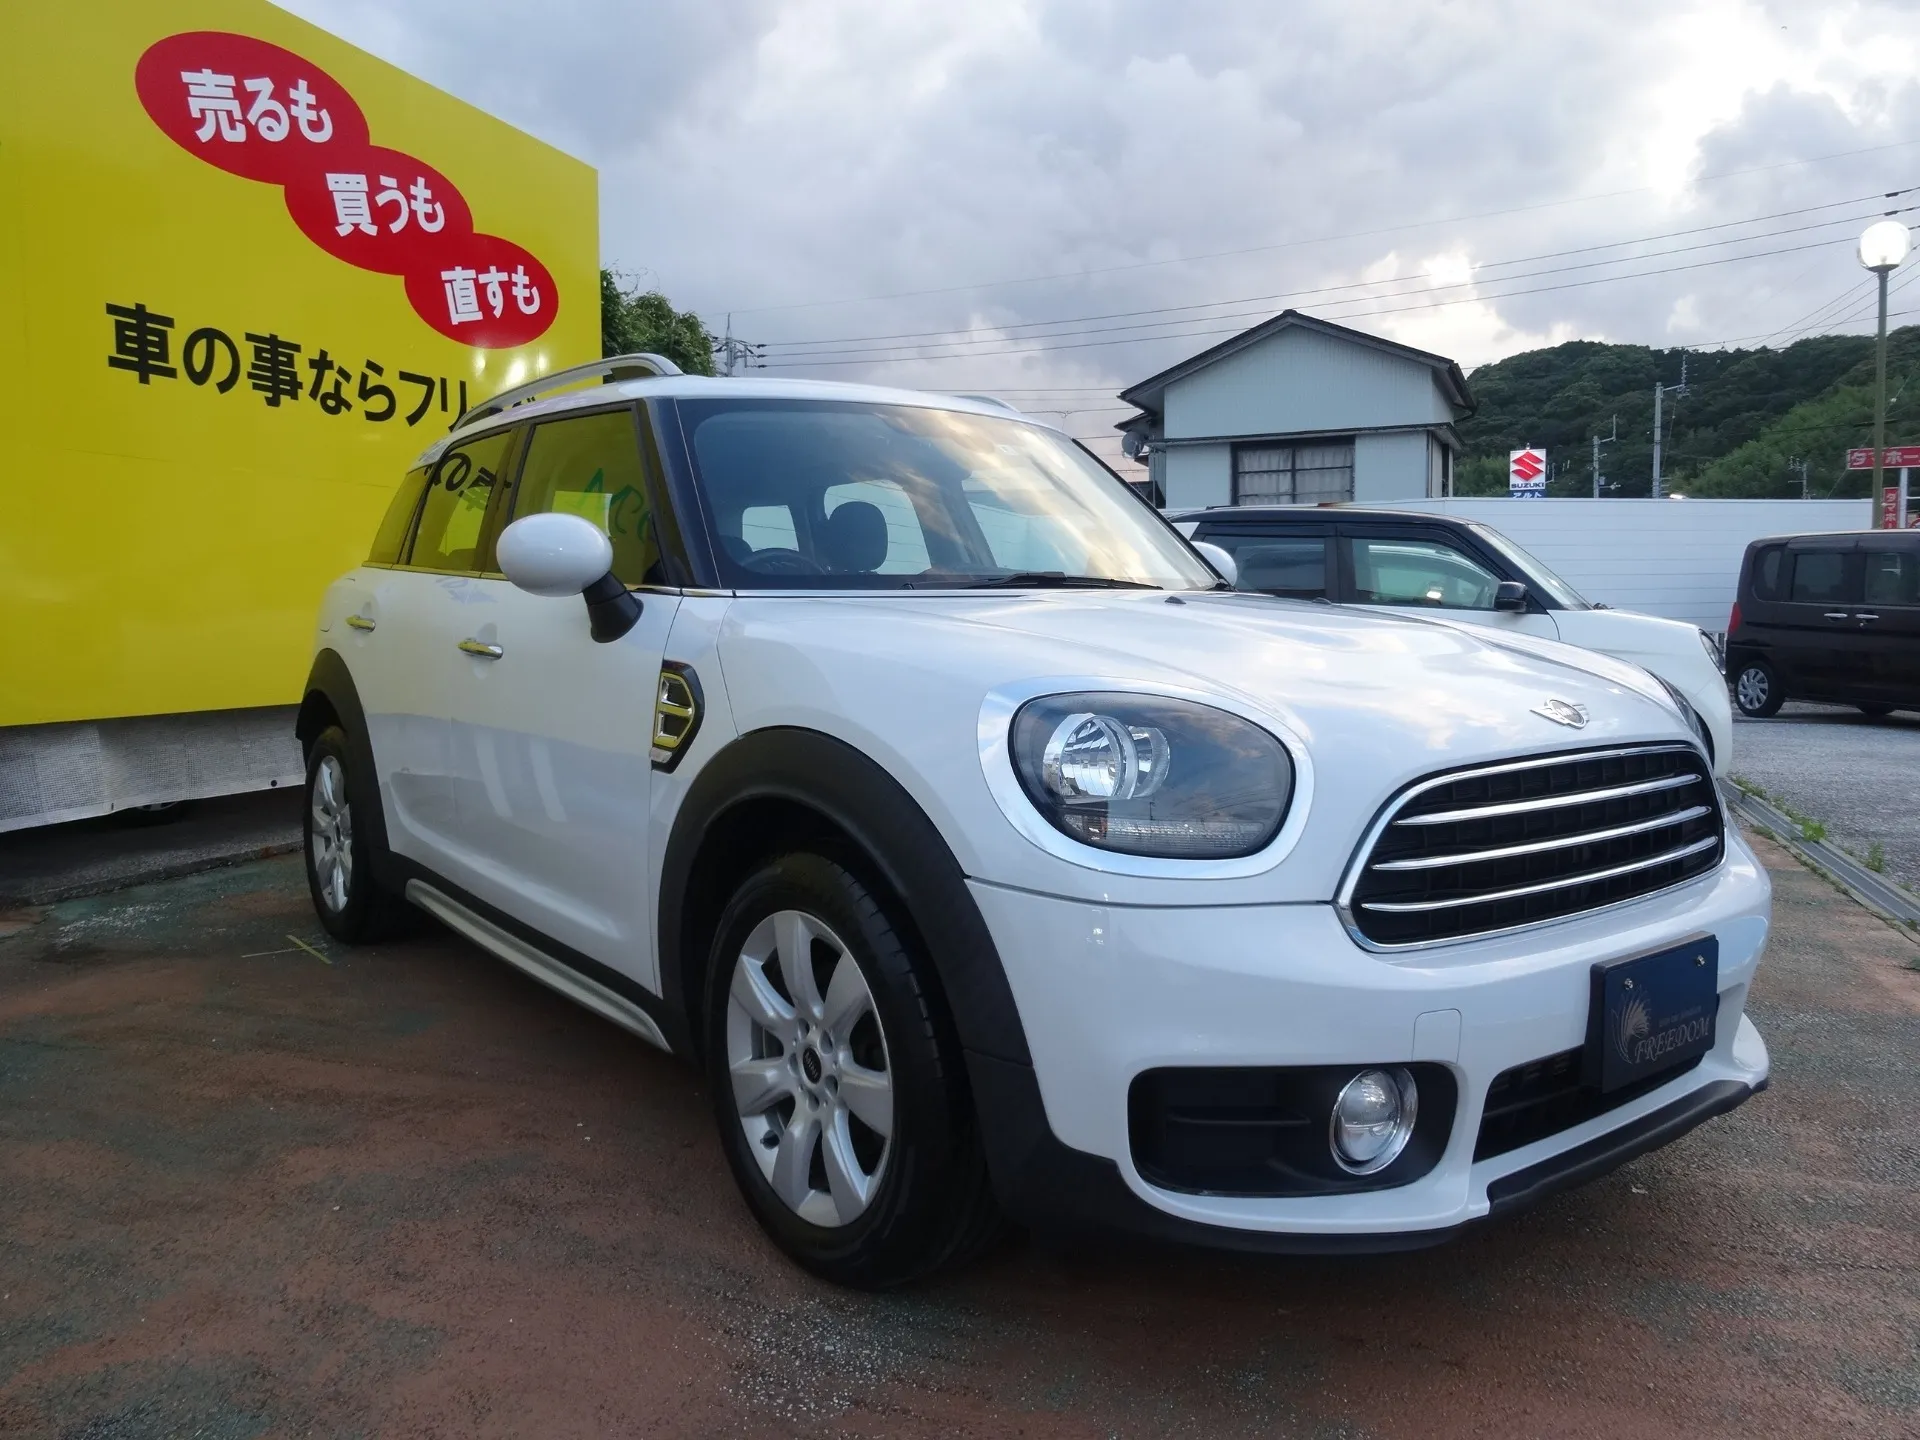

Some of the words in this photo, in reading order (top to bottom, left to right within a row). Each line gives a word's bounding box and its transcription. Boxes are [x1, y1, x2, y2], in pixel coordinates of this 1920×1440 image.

[180, 68, 333, 143] 売るも
[325, 172, 445, 237] 買うも
[441, 264, 540, 325] 直すも
[105, 302, 536, 432] 車の事ならフリ
[1635, 1016, 1709, 1063] FREEDOM
